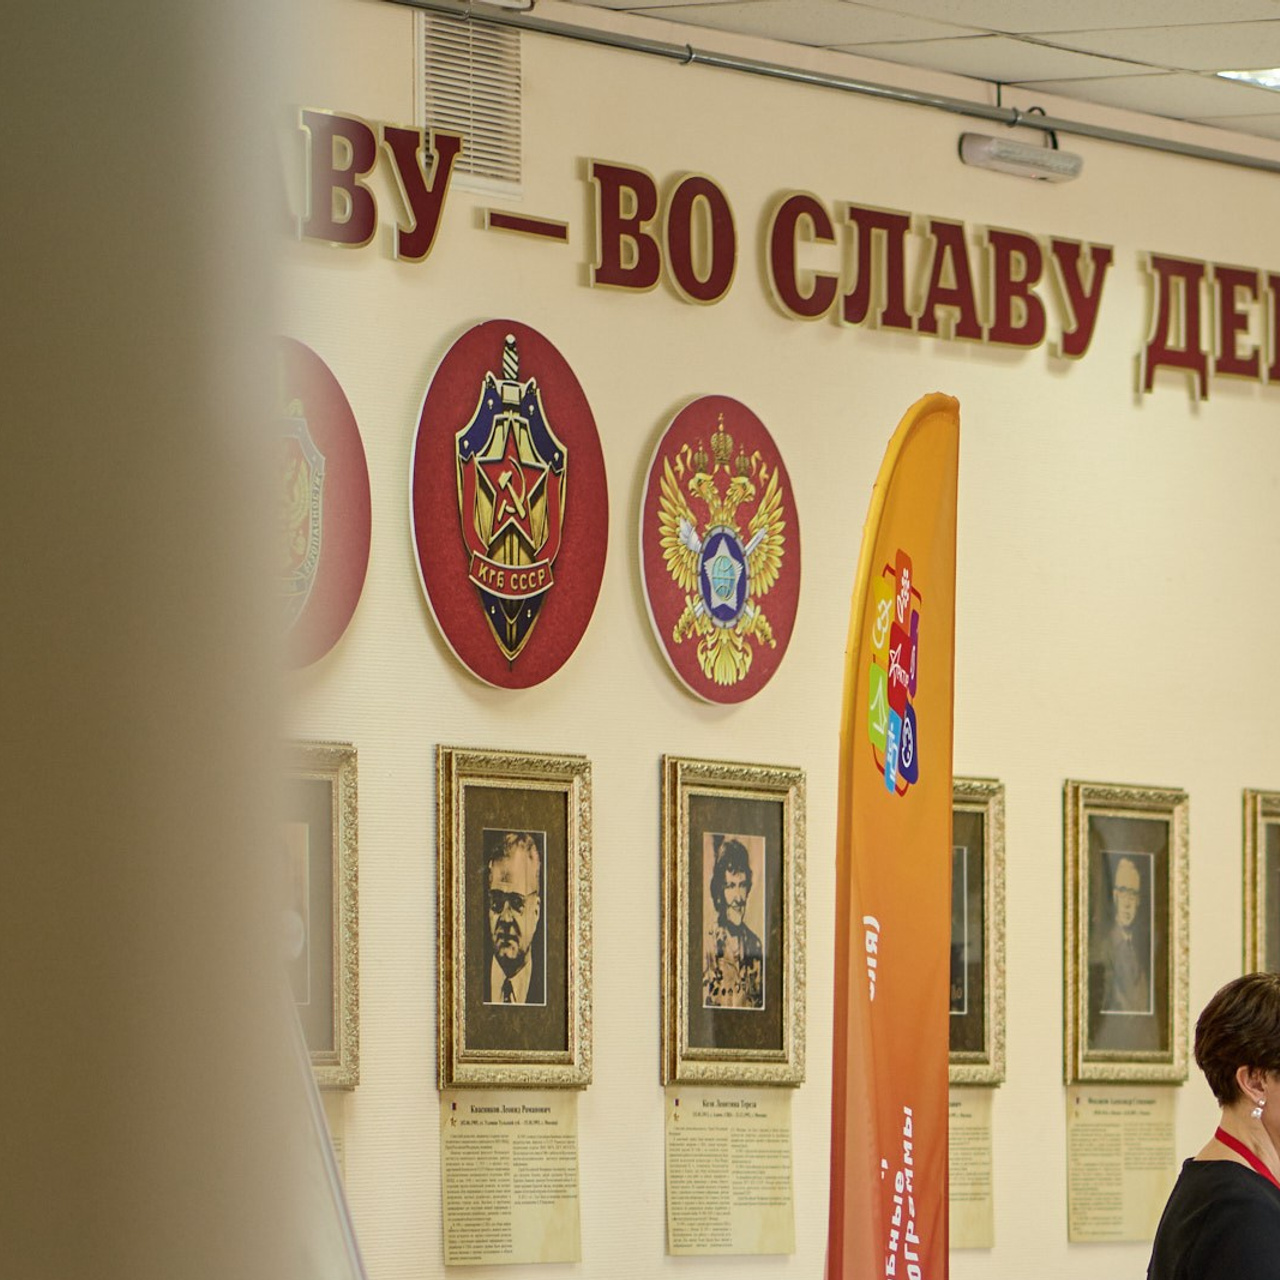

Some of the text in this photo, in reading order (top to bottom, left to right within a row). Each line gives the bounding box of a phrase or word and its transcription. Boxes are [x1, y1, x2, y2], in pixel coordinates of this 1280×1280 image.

[298, 108, 463, 263] ВУ
[589, 157, 738, 306] ВО
[766, 188, 1115, 361] СЛАВУ
[478, 562, 546, 591] КГБ СССР
